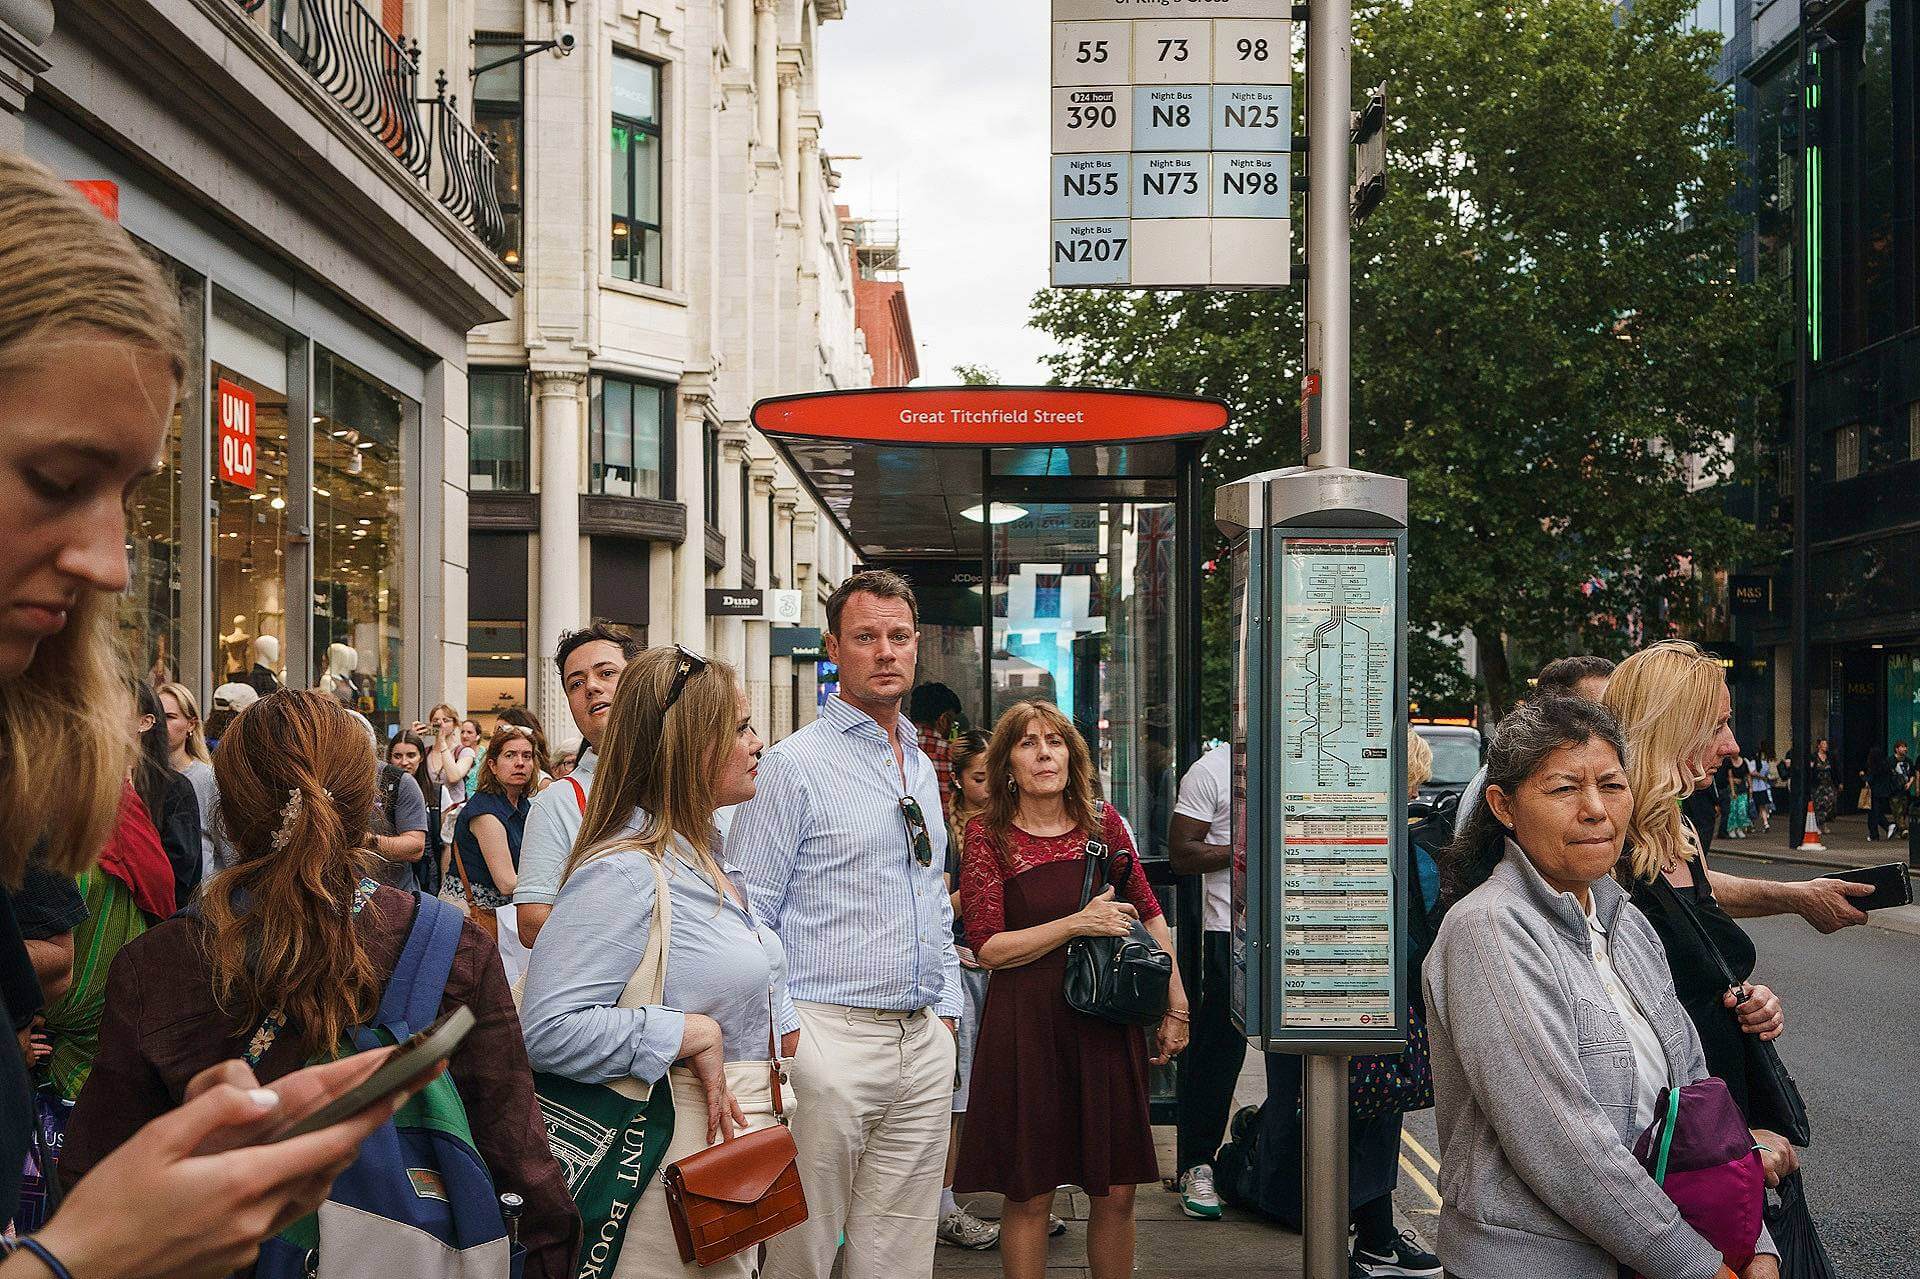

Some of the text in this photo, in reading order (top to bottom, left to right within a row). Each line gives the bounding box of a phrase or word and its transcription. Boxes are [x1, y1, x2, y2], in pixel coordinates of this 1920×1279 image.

[1076, 41, 1108, 63] 55
[1157, 40, 1188, 61] 73
[1236, 39, 1268, 61] 98
[1151, 92, 1173, 101] Night
[1231, 92, 1254, 101] Night
[1067, 106, 1116, 128] 390
[1153, 105, 1190, 127] N8
[1225, 106, 1279, 128] N25
[1070, 160, 1111, 170] Night Bus
[1150, 160, 1173, 168] Night
[1231, 159, 1271, 168] Night Bus
[1064, 173, 1118, 196] N55
[1144, 173, 1198, 195] N73
[1224, 173, 1278, 195] N98
[1070, 226, 1111, 235] Night Bus
[1055, 239, 1127, 262] N207
[223, 393, 250, 436] UNI
[900, 409, 1084, 423] Great Titchfield Street
[223, 435, 252, 476] QLO
[722, 596, 759, 606] Dune
[1736, 587, 1762, 598] M&S
[1285, 980, 1305, 988] N207
[31, 1129, 65, 1148] LUS
